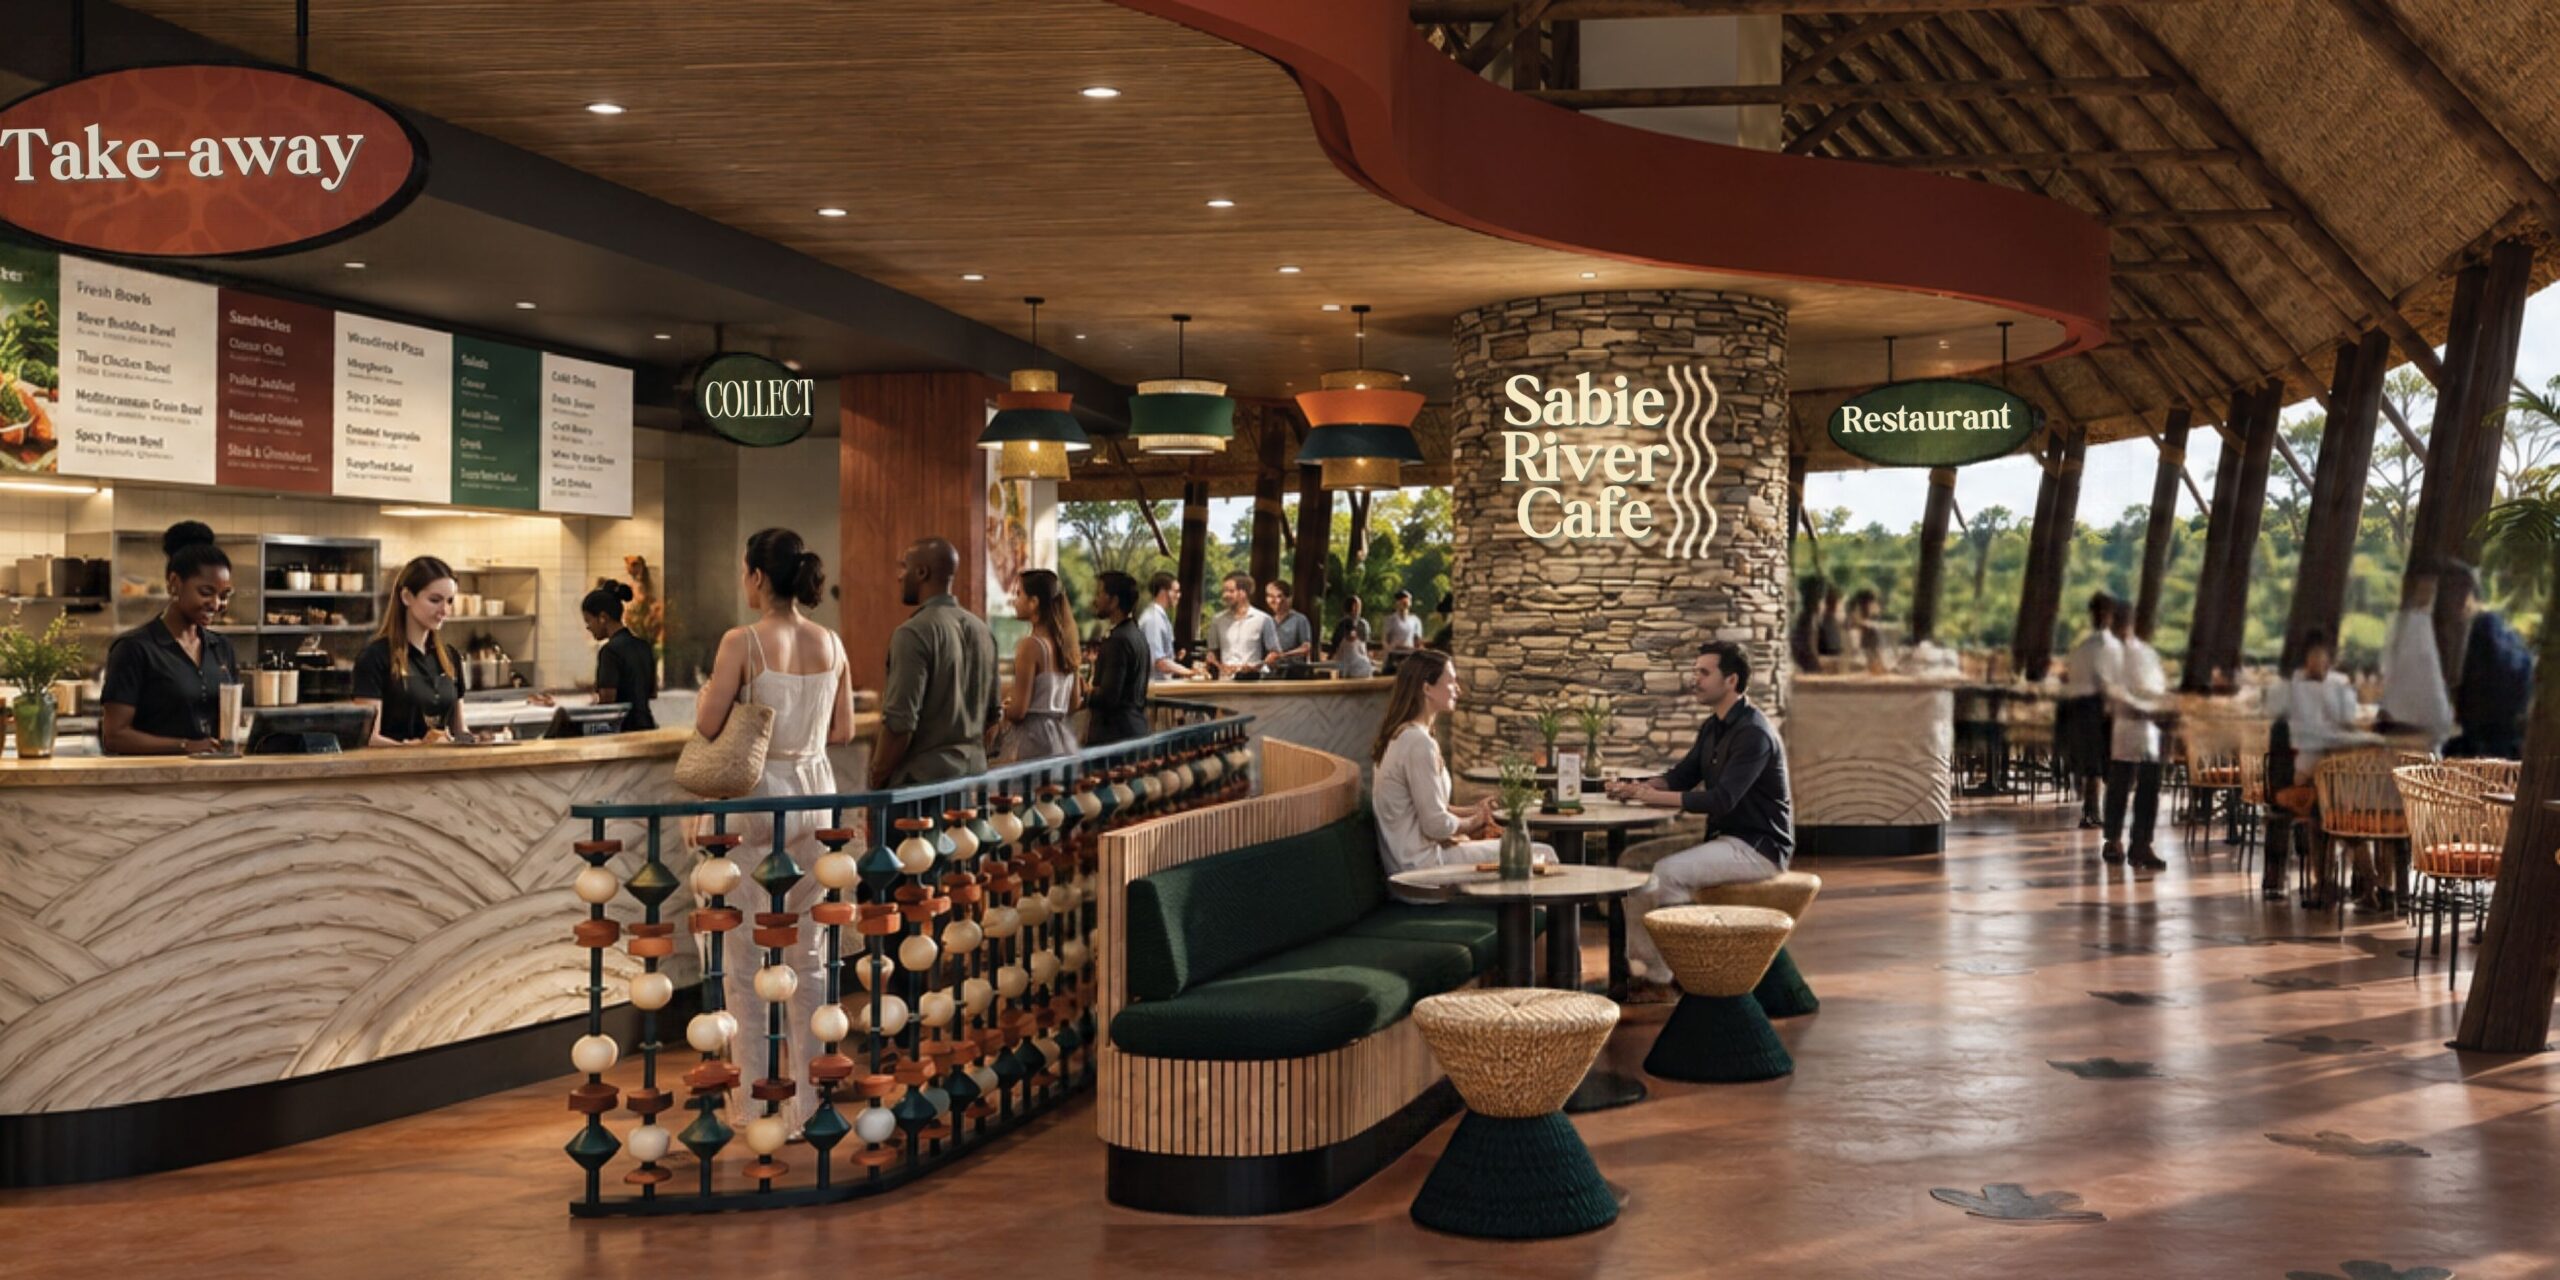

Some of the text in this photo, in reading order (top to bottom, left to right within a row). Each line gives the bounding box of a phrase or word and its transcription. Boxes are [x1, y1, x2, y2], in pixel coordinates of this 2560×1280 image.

[0, 122, 366, 192] Take-away
[77, 281, 112, 299] Fresh
[705, 379, 814, 418] COLLECT
[1504, 371, 1665, 426] Sabie
[1841, 402, 2012, 433] Restaurant
[1501, 430, 1670, 483] River
[1517, 485, 1652, 539] Cafe
